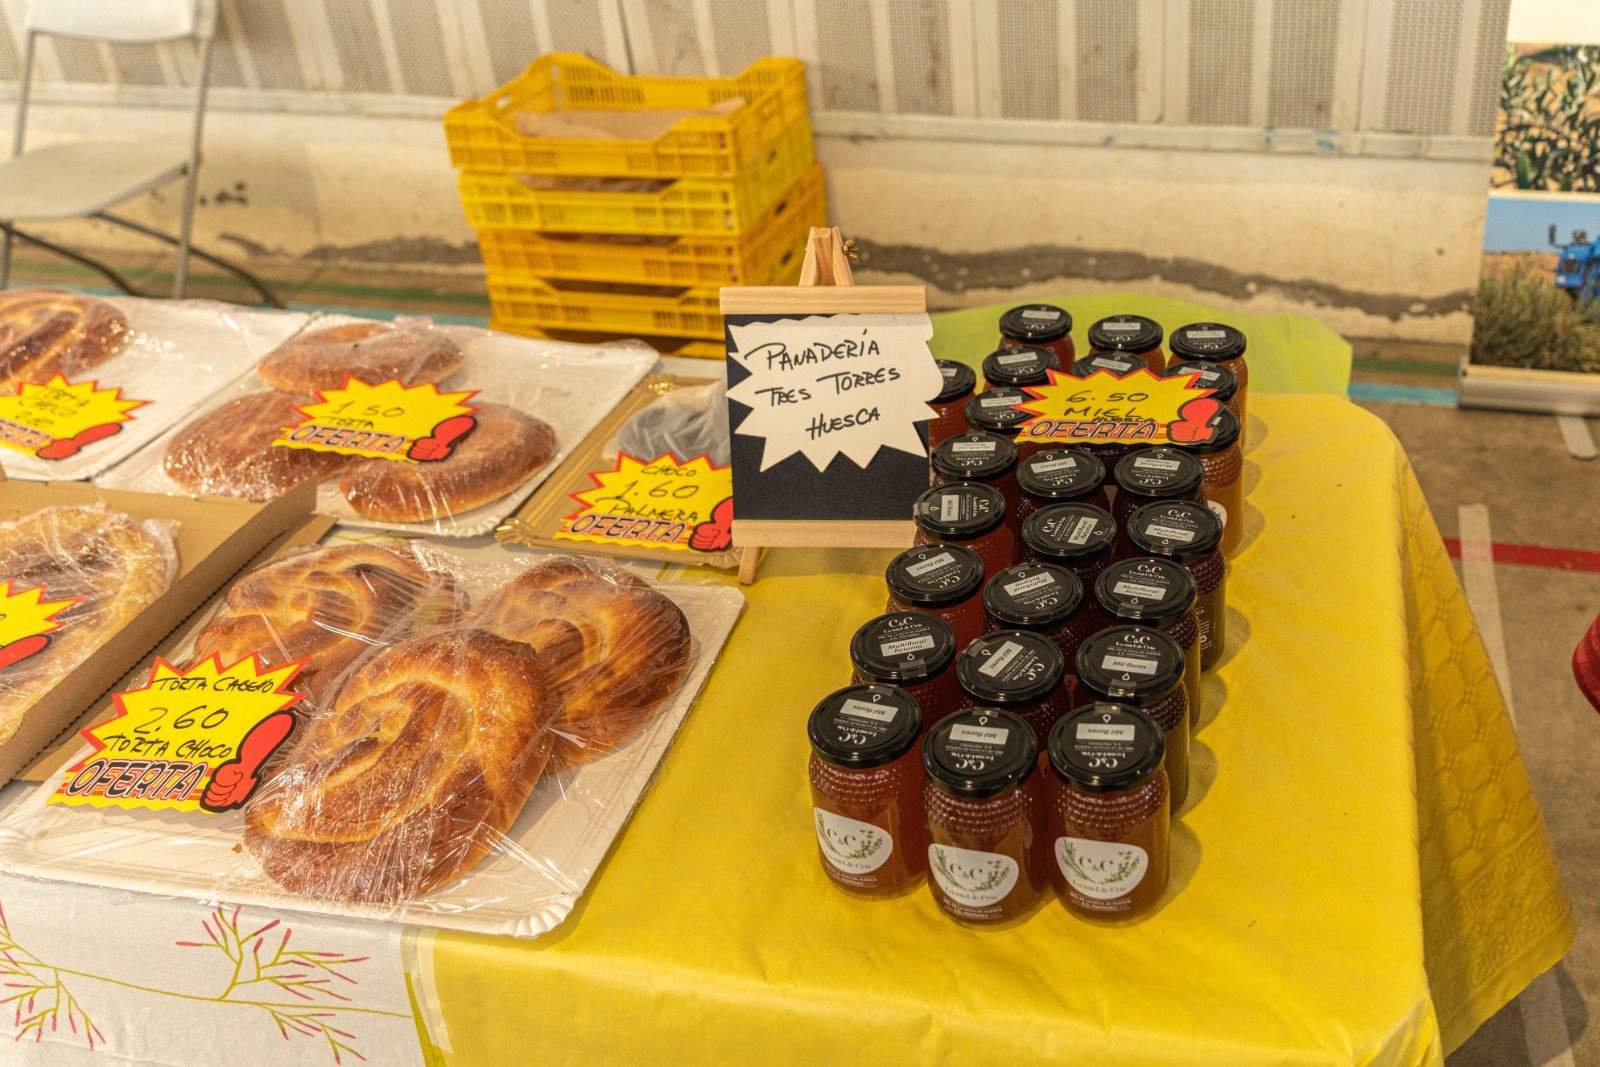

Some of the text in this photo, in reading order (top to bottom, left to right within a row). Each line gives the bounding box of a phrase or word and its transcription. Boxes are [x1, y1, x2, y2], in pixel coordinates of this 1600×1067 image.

[744, 329, 880, 371] PANADERÍA
[755, 368, 900, 407] TRES TORRES
[805, 407, 880, 441] HUESCA
[1064, 406, 1142, 418] MIEL
[289, 425, 406, 452] OFERTA
[1028, 420, 1158, 439] OFERTA
[641, 465, 697, 477] CHOCO
[595, 497, 699, 522] PALMERA
[569, 514, 687, 543] OFERTA
[153, 677, 207, 691] TORTA
[103, 733, 232, 759] TORTA CHOCO
[66, 759, 209, 802] OFERTA
[827, 828, 856, 848] C&C
[950, 863, 983, 880] C&C
[1079, 856, 1114, 871] C&C
